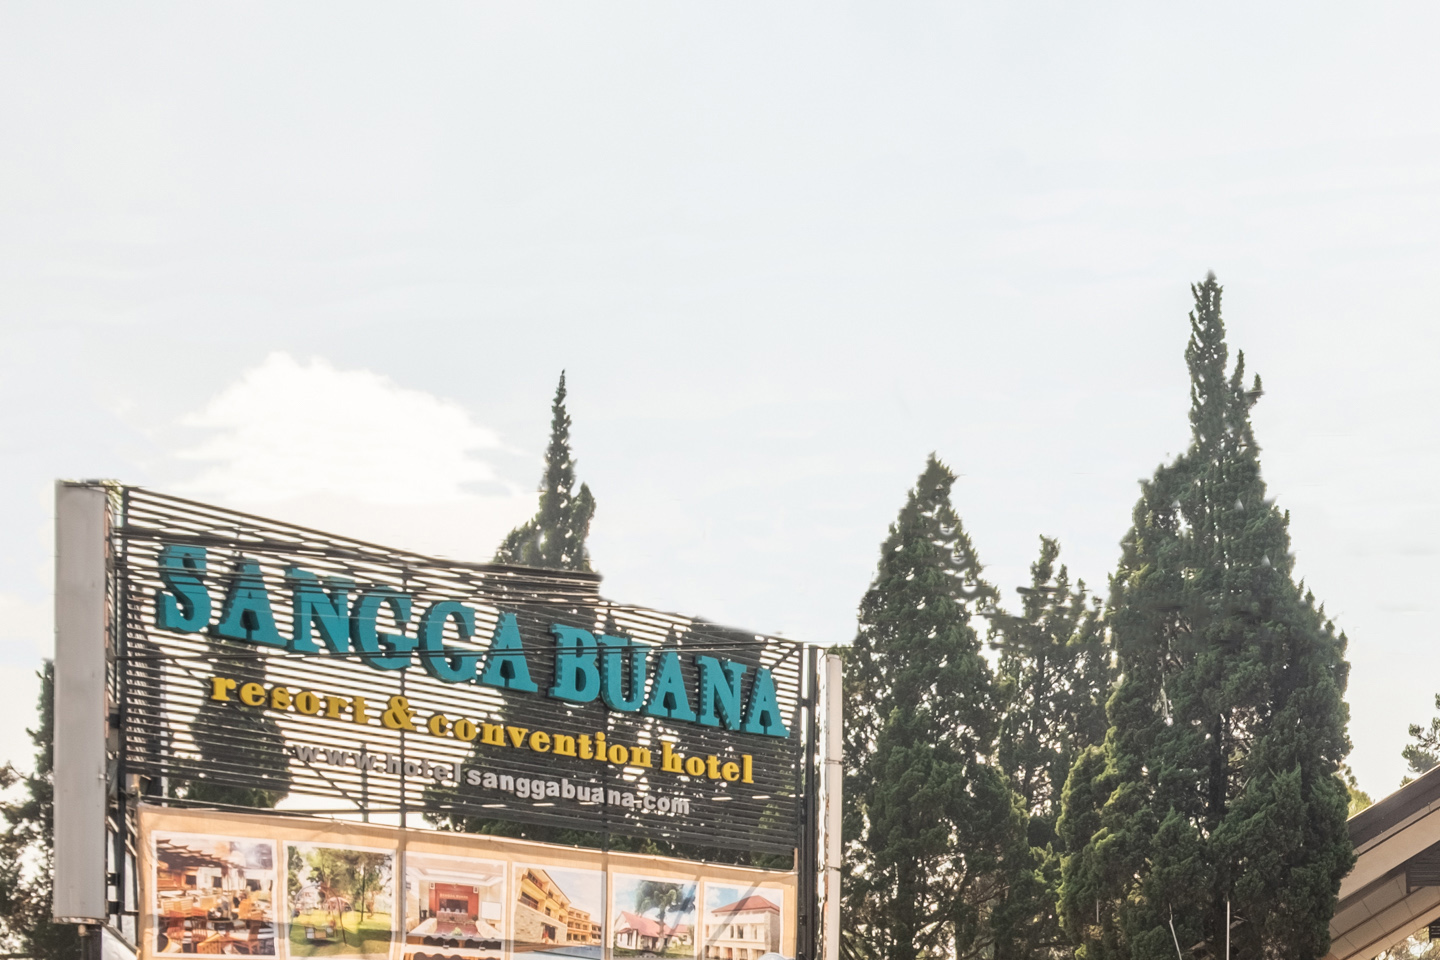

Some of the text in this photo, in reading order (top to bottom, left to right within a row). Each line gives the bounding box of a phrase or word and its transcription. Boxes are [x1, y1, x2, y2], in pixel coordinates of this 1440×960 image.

[158, 544, 791, 738] SANGGA BUANA
[209, 676, 754, 784] resort & convention hotel
